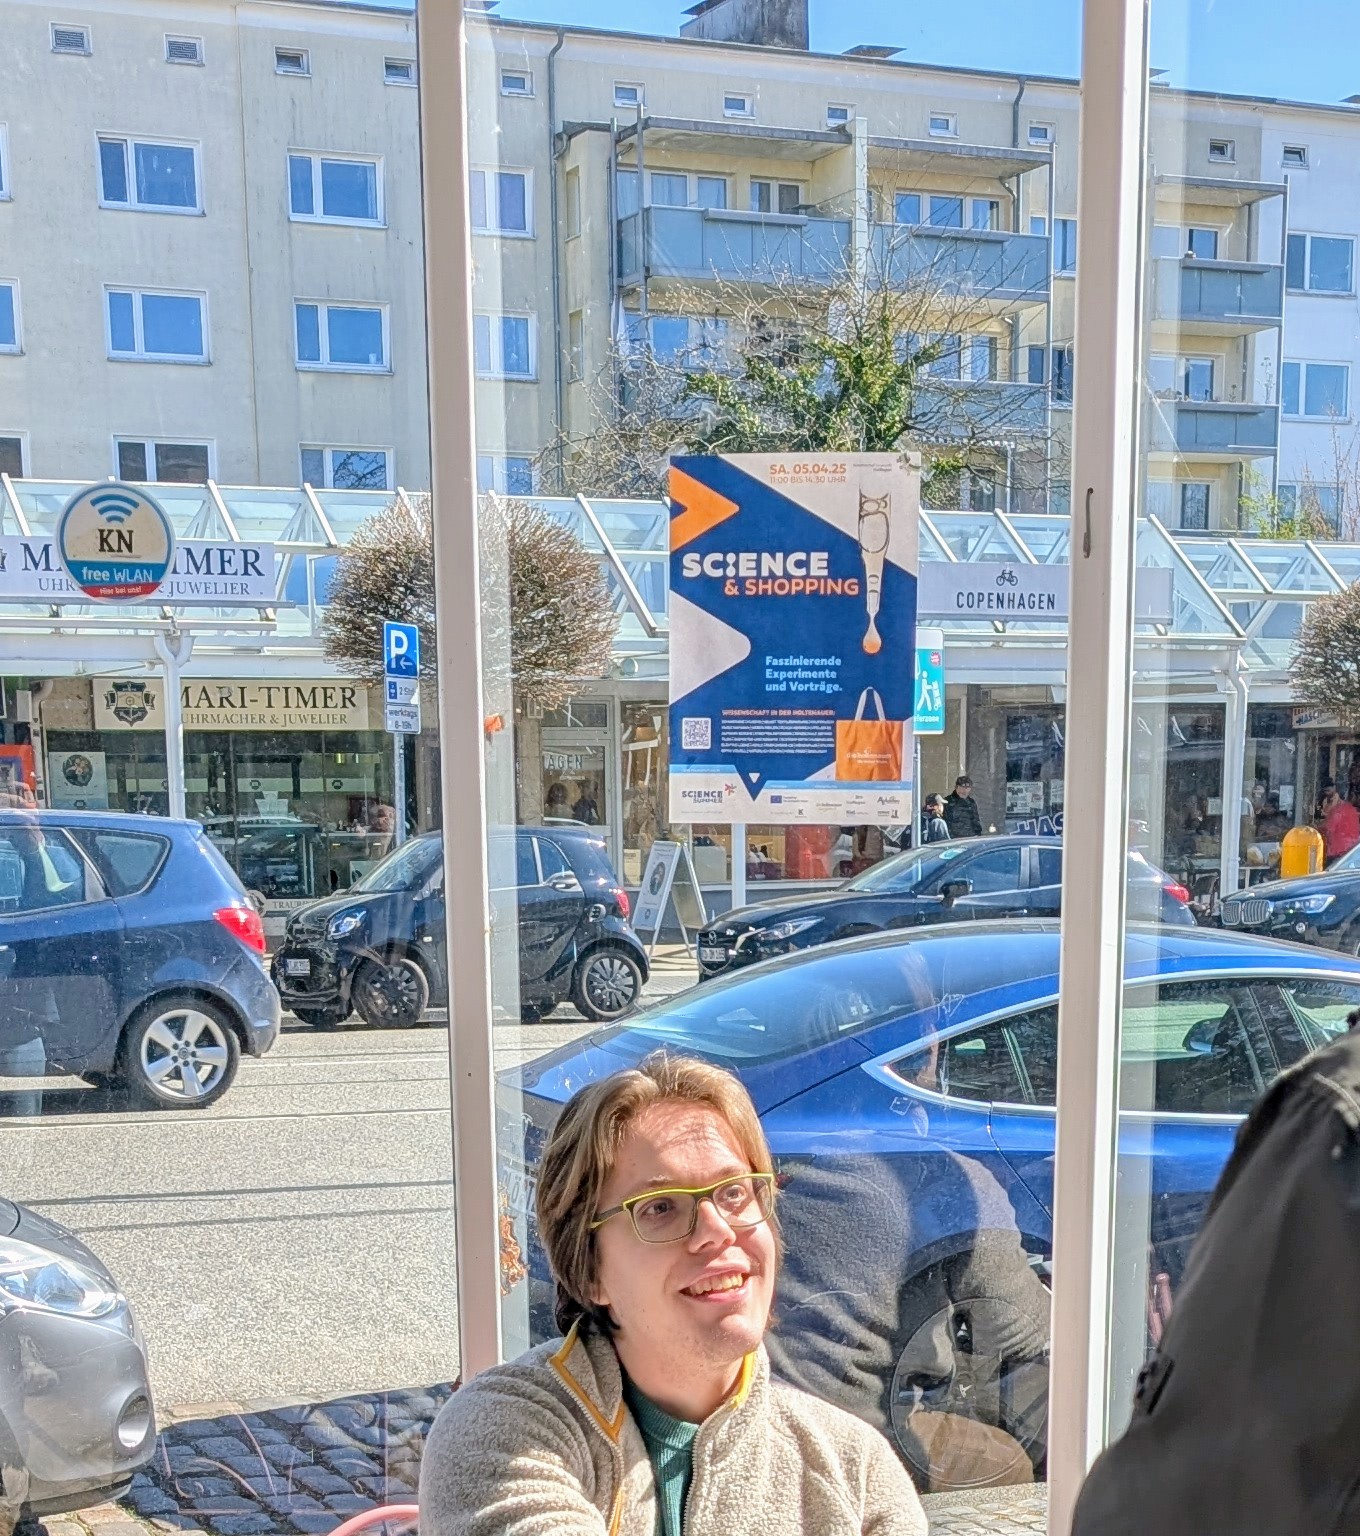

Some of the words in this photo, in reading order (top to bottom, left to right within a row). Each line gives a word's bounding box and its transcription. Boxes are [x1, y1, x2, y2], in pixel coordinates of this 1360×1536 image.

[769, 464, 790, 475] SA.
[793, 463, 847, 475] 05.04.25
[98, 529, 134, 553] KN
[682, 552, 829, 578] SCIENCE
[82, 567, 110, 582] free
[113, 568, 153, 583] WLAN
[168, 580, 251, 597] JUWELIER
[724, 579, 740, 596] &
[745, 579, 859, 596] SHOPPING
[956, 591, 1056, 610] COPENHAGEN
[765, 656, 842, 666] Faszinierende
[765, 669, 837, 680] Experimente
[765, 681, 787, 692] und
[789, 681, 842, 694] Vorträge.
[181, 713, 268, 725] UHRMACHER
[269, 714, 279, 725] &
[281, 713, 348, 727] JUWELIER
